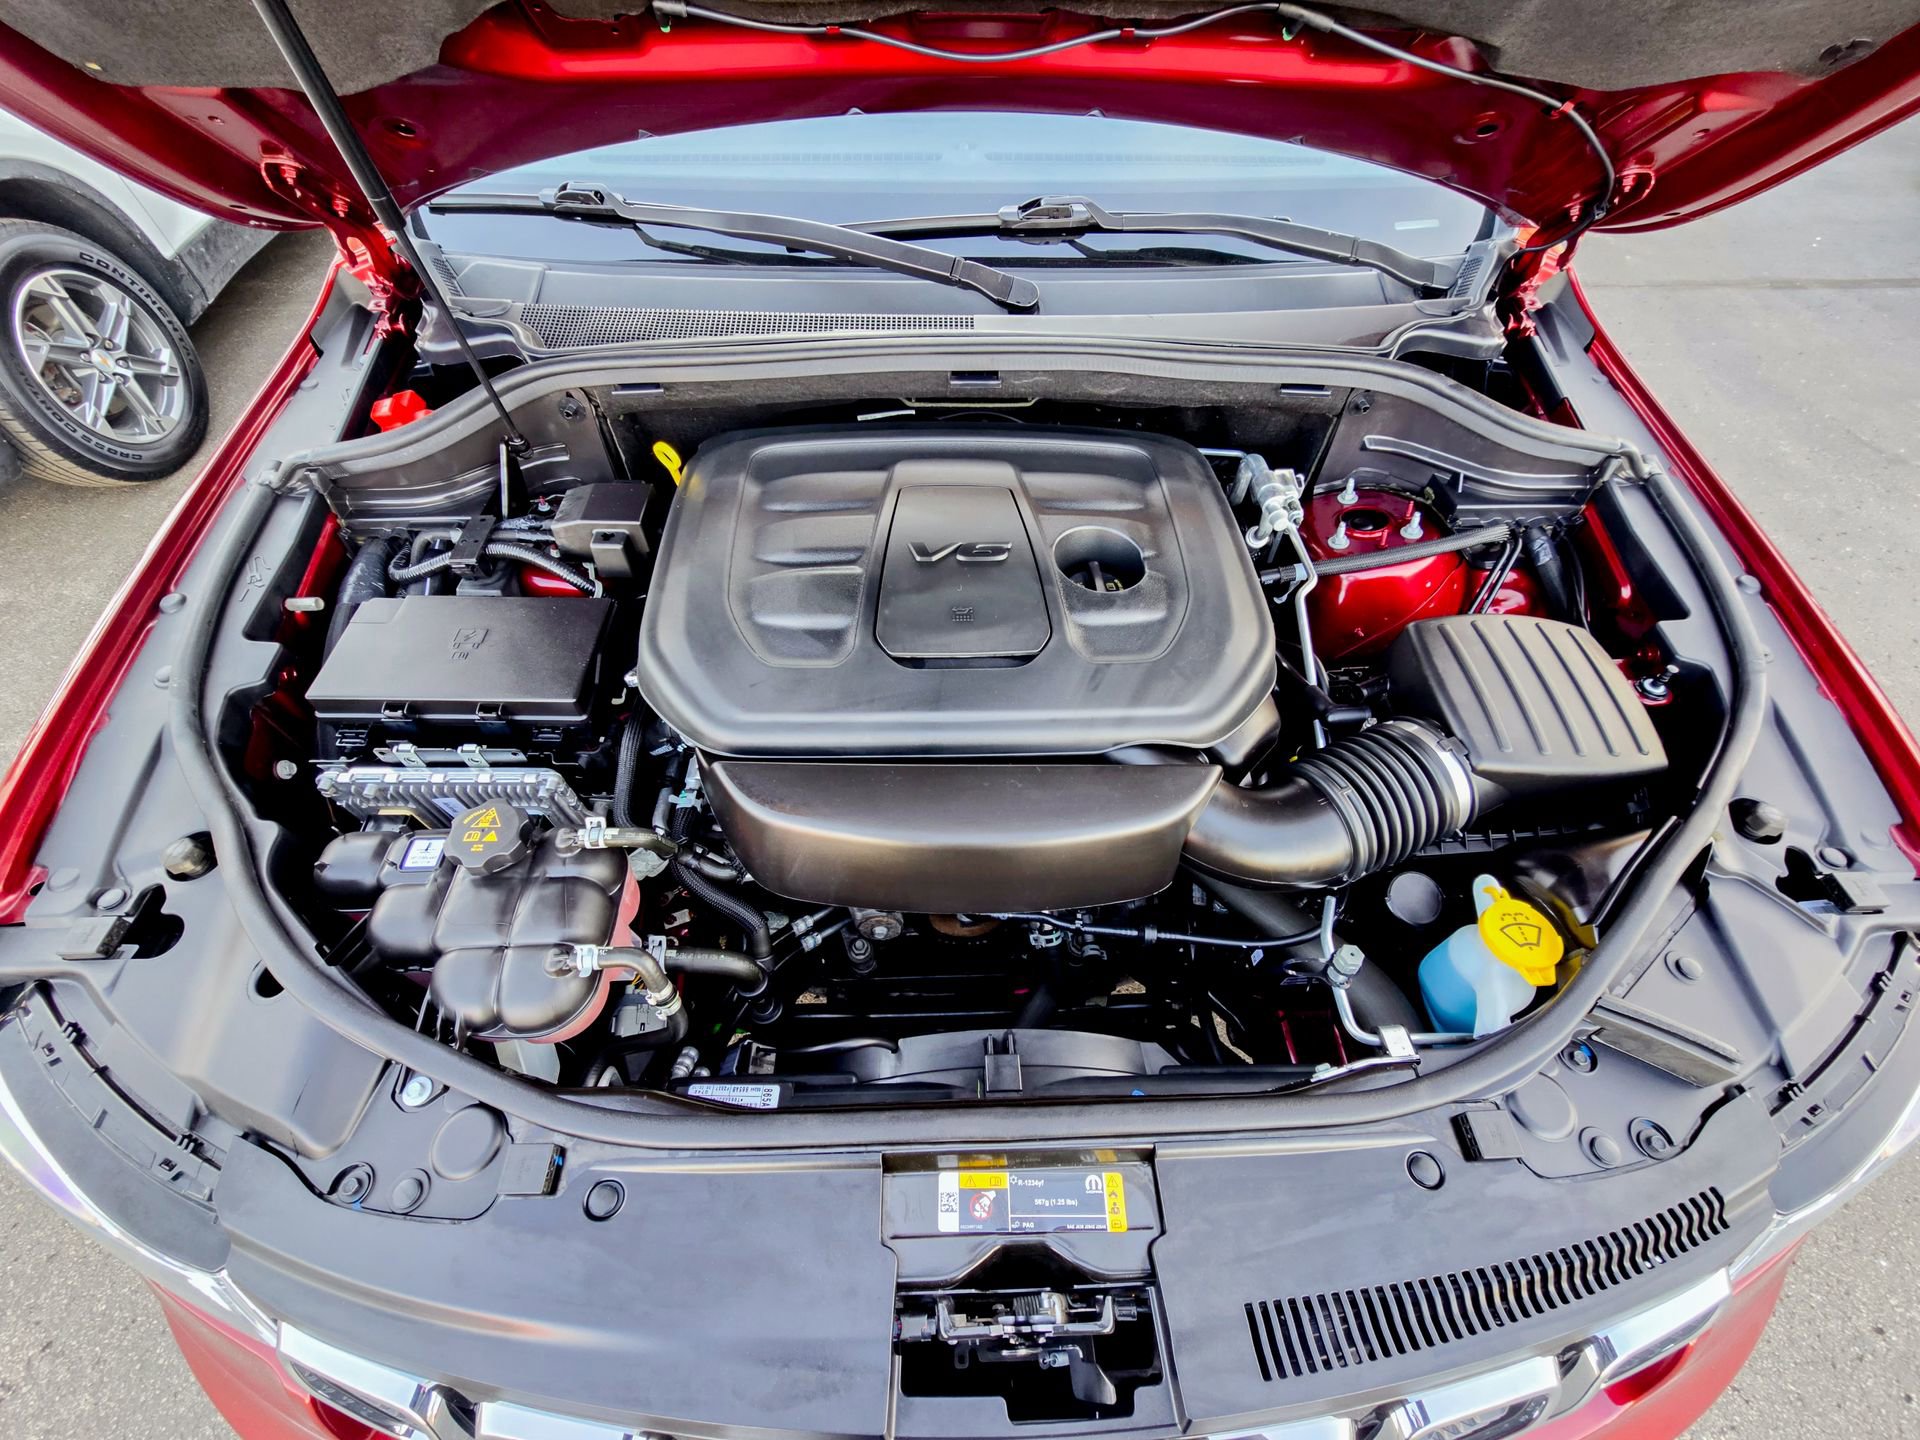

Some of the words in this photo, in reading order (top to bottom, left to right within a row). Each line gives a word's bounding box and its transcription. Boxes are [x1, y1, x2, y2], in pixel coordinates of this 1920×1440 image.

[79, 251, 195, 365] CONTINENTAL
[79, 433, 143, 461] CROSS
[907, 542, 1012, 562] V6
[762, 1088, 773, 1106] 865A
[1017, 1179, 1045, 1188] R-1234yf
[1034, 1198, 1050, 1207] 567g
[1050, 1198, 1065, 1207] (1.25
[1066, 1198, 1078, 1207] lbs)
